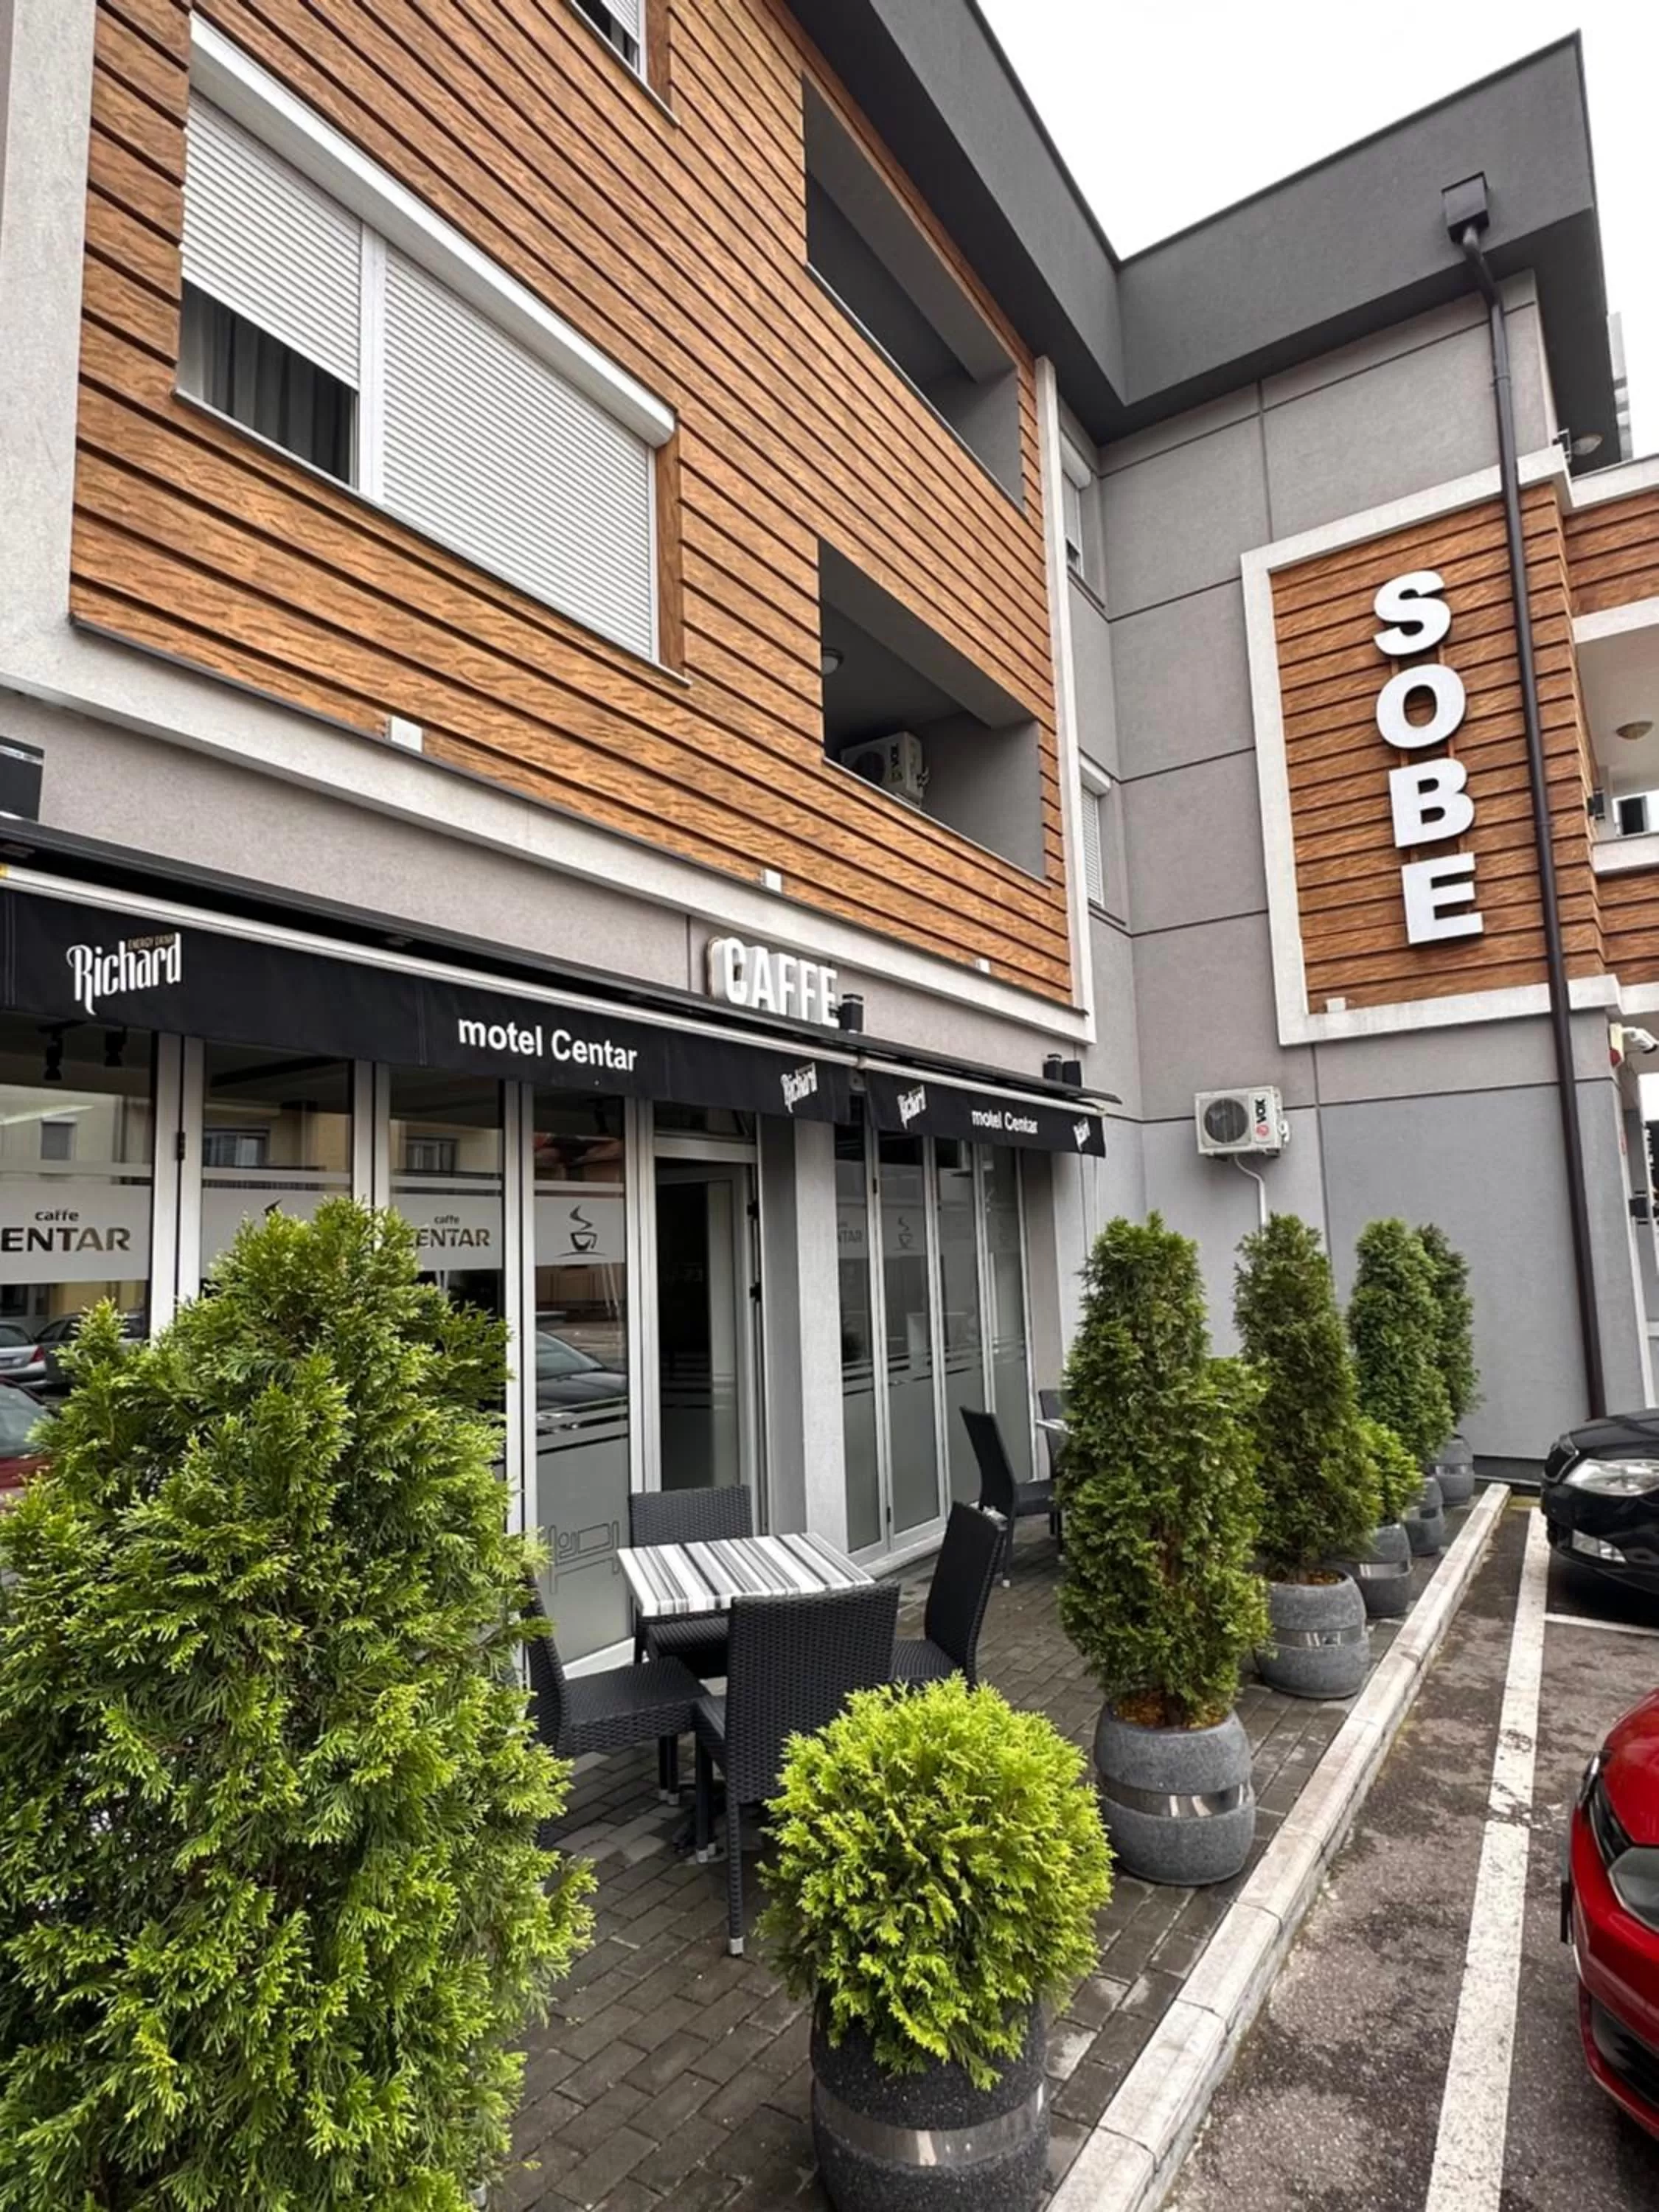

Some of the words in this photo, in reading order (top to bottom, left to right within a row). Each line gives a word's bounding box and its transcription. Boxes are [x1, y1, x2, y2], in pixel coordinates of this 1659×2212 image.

[1372, 569, 1484, 946] SOBE
[66, 932, 181, 1015] Richard
[720, 936, 840, 1029] CAFFE
[458, 1018, 543, 1057] motel
[552, 1029, 638, 1071] Centar
[971, 1110, 1003, 1130] motel
[1004, 1111, 1039, 1135] Centar
[1255, 1099, 1267, 1124] VOX
[35, 1209, 79, 1221] caffe
[434, 1215, 460, 1224] caffe
